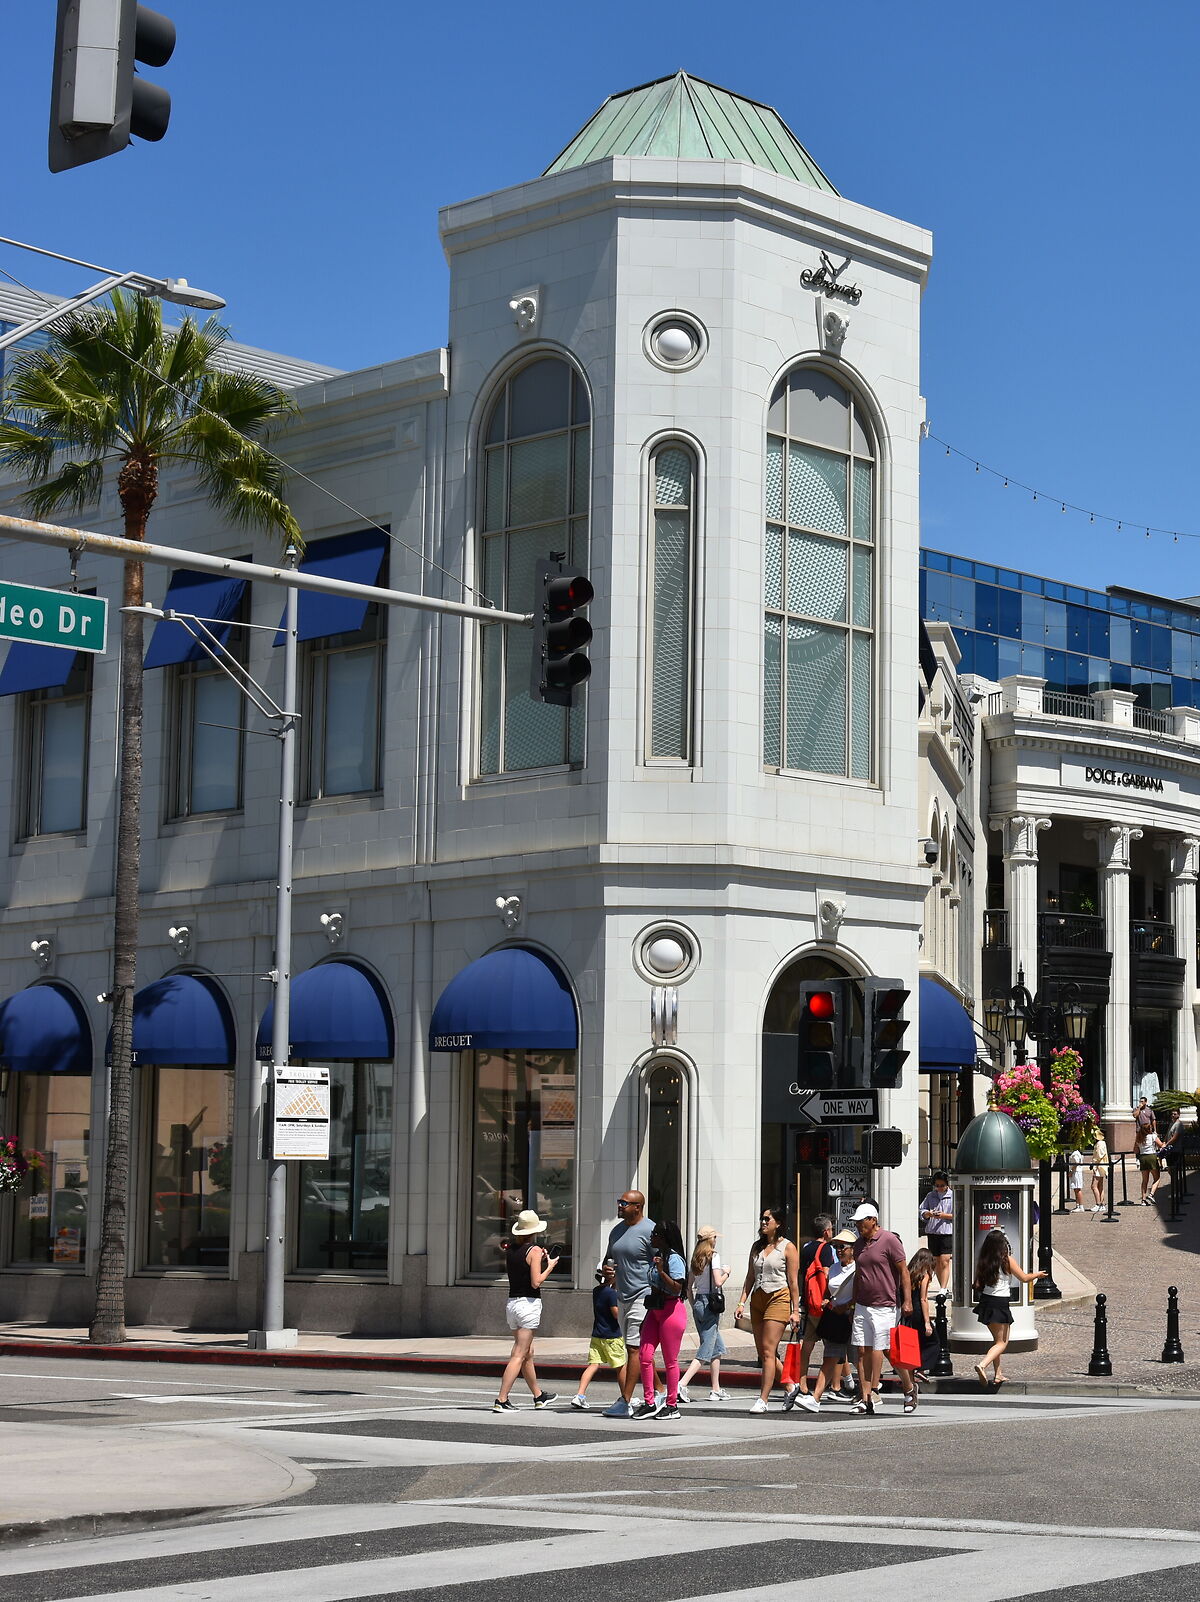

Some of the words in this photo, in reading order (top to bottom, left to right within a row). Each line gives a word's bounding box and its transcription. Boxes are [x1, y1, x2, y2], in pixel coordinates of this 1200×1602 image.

[59, 605, 92, 636] Dr
[1086, 767, 1117, 782] DOLCE
[1122, 772, 1163, 791] GABBANA
[434, 1034, 472, 1047] BREGUET
[823, 1101, 844, 1114] ONE
[847, 1100, 868, 1113] WAY
[830, 1156, 862, 1164] DIAGONA
[829, 1165, 867, 1174] CROSSING
[829, 1178, 843, 1191] OK
[983, 1202, 1012, 1210] TUDOR
